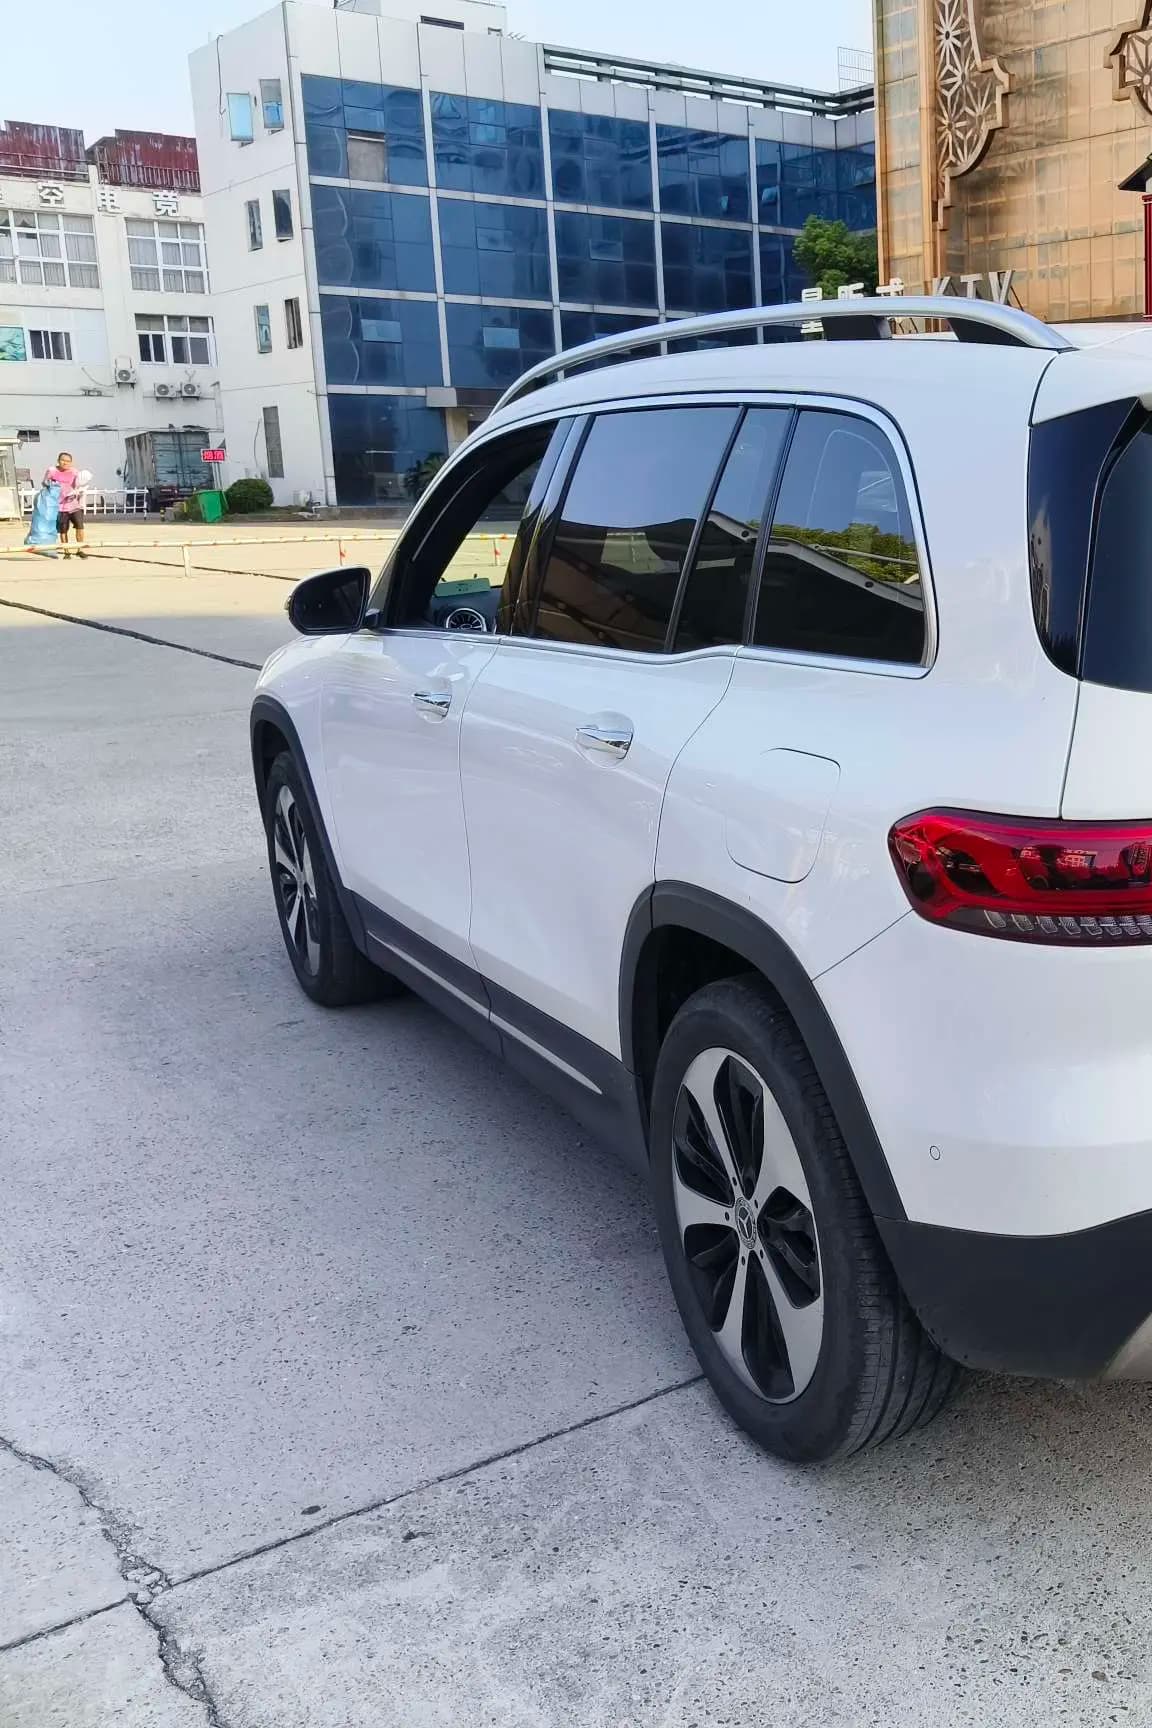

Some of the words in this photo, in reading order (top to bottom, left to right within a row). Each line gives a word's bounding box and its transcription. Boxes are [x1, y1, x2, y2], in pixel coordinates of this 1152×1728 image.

[0, 181, 180, 217] 空电竞
[932, 271, 1015, 306] KTV
